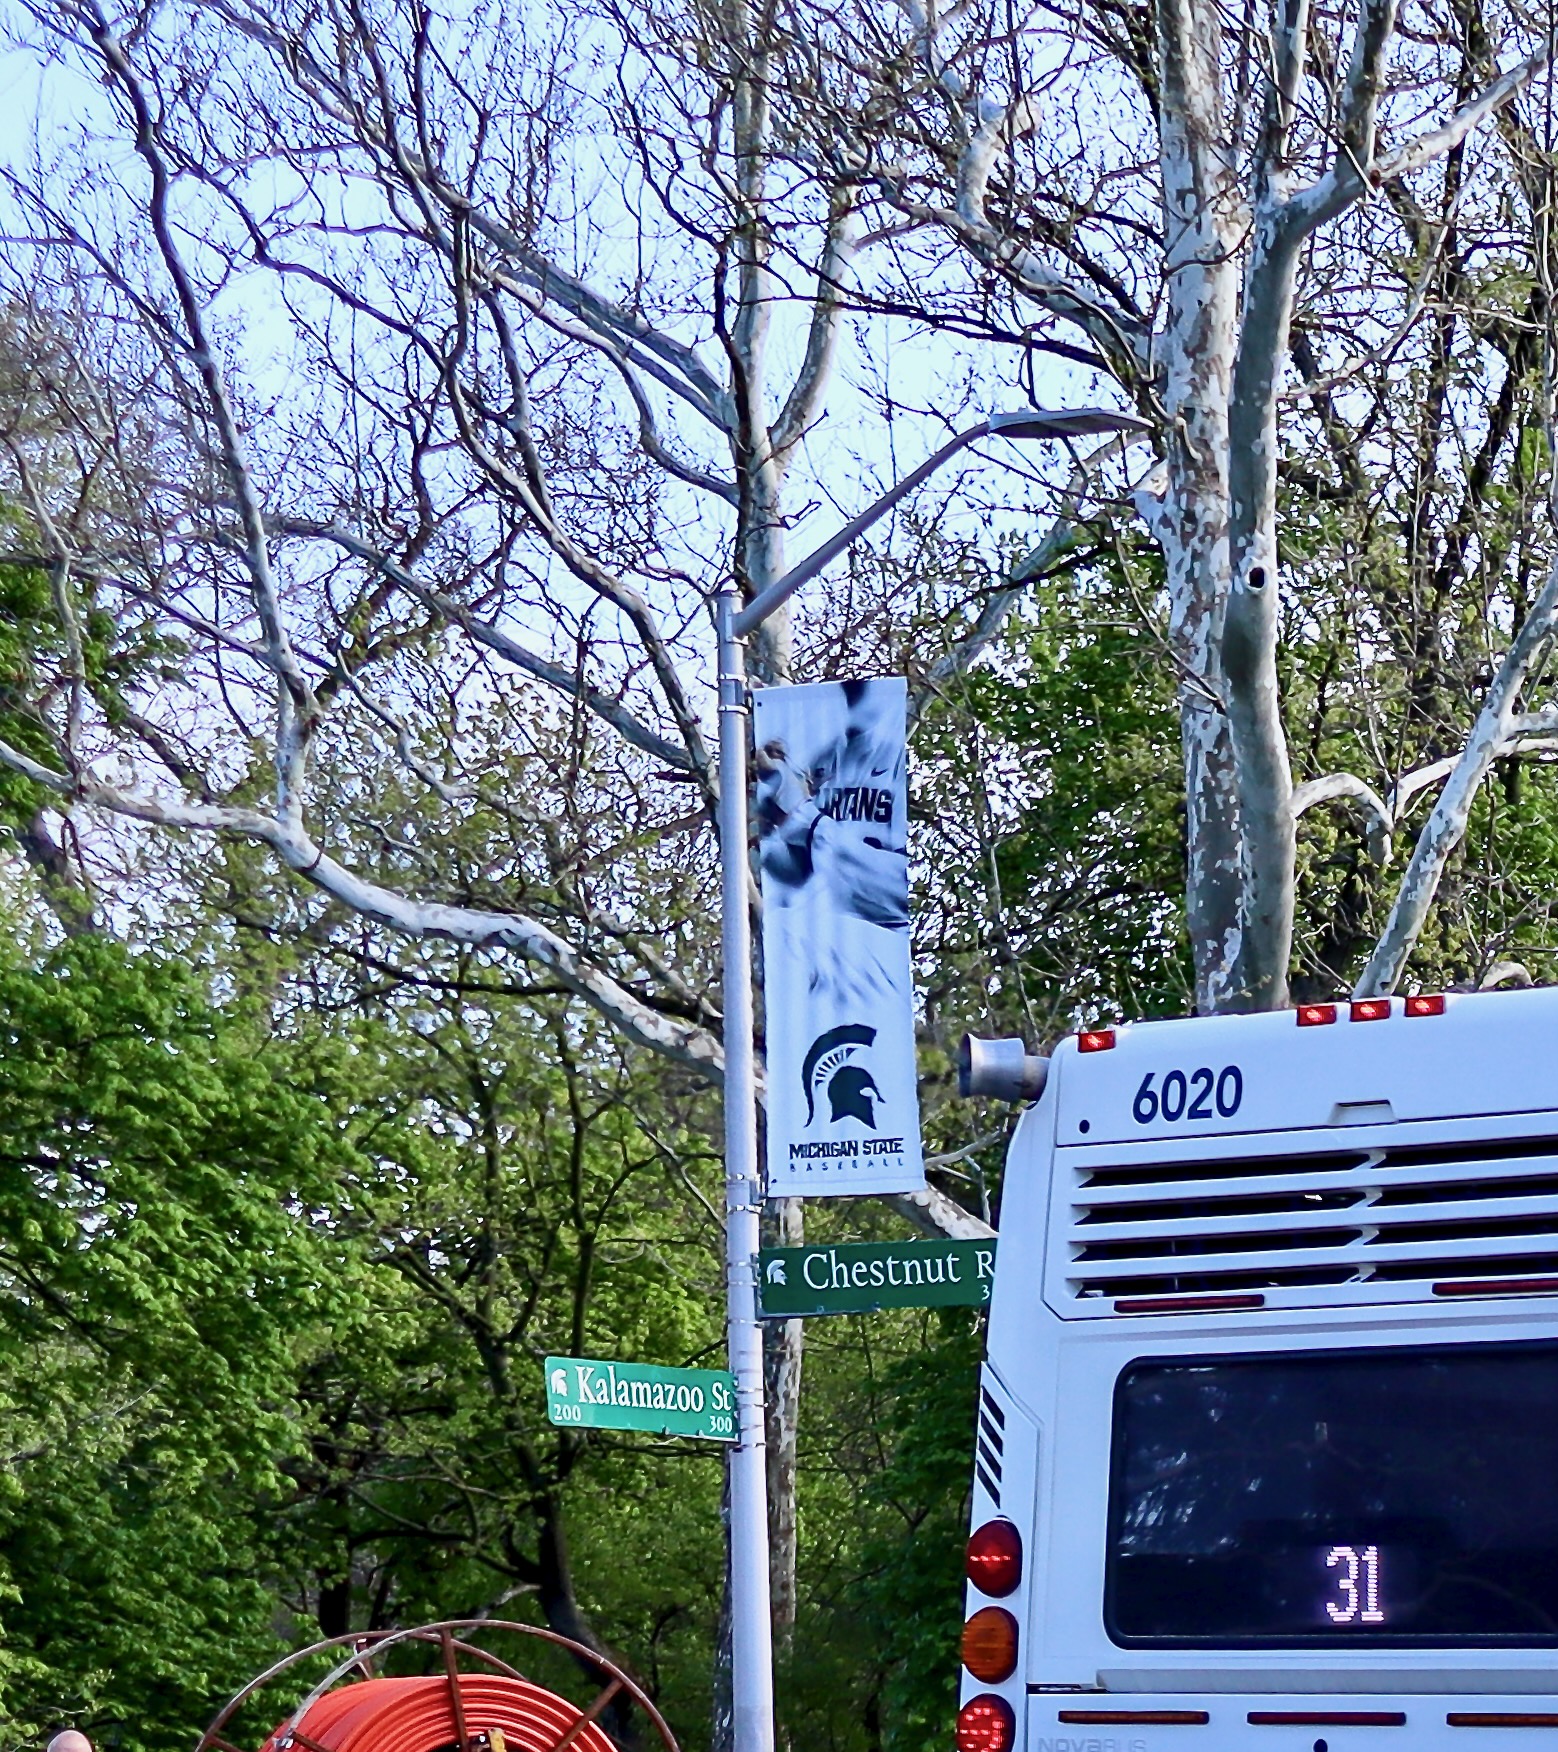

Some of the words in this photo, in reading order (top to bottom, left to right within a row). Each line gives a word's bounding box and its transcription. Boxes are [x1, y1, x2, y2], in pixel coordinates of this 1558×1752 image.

[1133, 1065, 1242, 1124] 6020
[789, 1141, 858, 1159] MICHIGAN
[863, 1138, 904, 1155] STATE
[790, 1158, 903, 1172] BASEBALL
[803, 1250, 961, 1290] Chestnut
[975, 1250, 994, 1279] R
[981, 1284, 990, 1301] 3
[575, 1365, 703, 1413] Kalamazoo
[712, 1382, 732, 1411] St
[554, 1404, 581, 1422] 200
[710, 1416, 732, 1433] 300
[1326, 1546, 1384, 1622] 31
